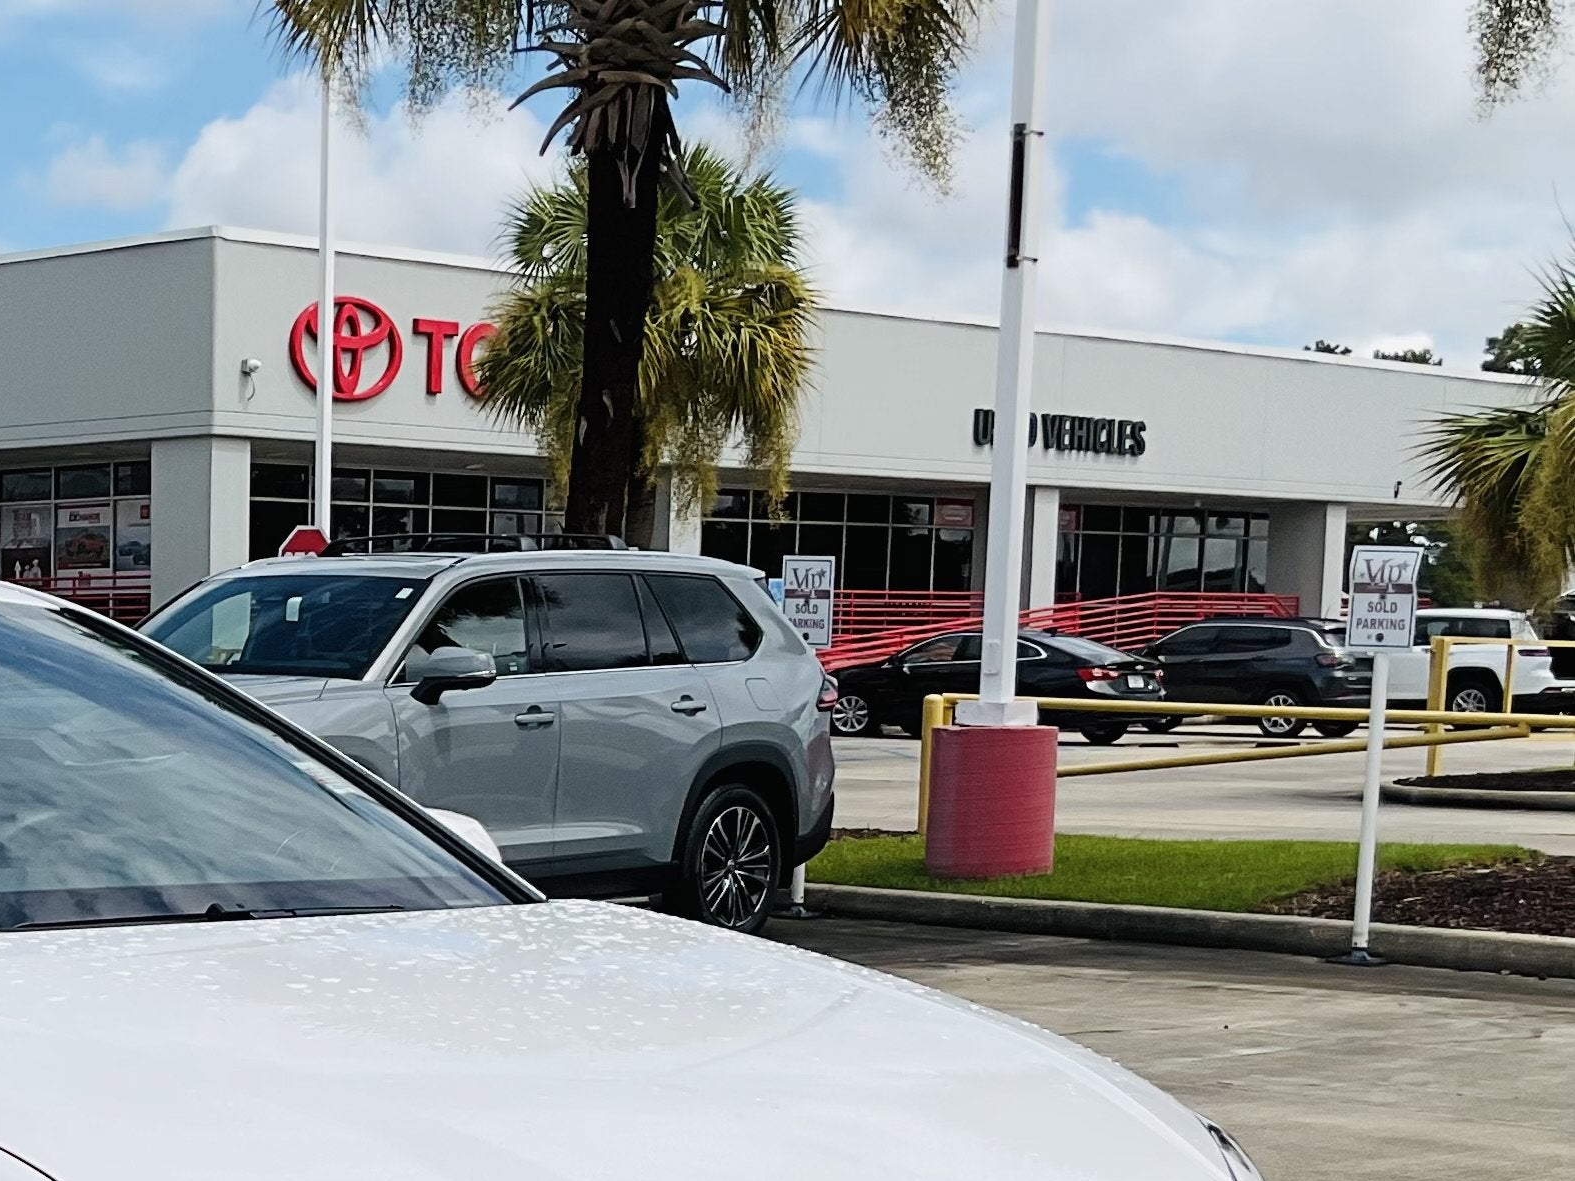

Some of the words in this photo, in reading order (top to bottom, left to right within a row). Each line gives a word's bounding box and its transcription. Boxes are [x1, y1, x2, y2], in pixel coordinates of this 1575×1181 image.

[973, 408, 1037, 448] UD
[1041, 413, 1146, 456] VEHICLES
[795, 603, 819, 614] SOLD
[1367, 601, 1398, 613] SOLD
[1356, 618, 1406, 630] PARKING
